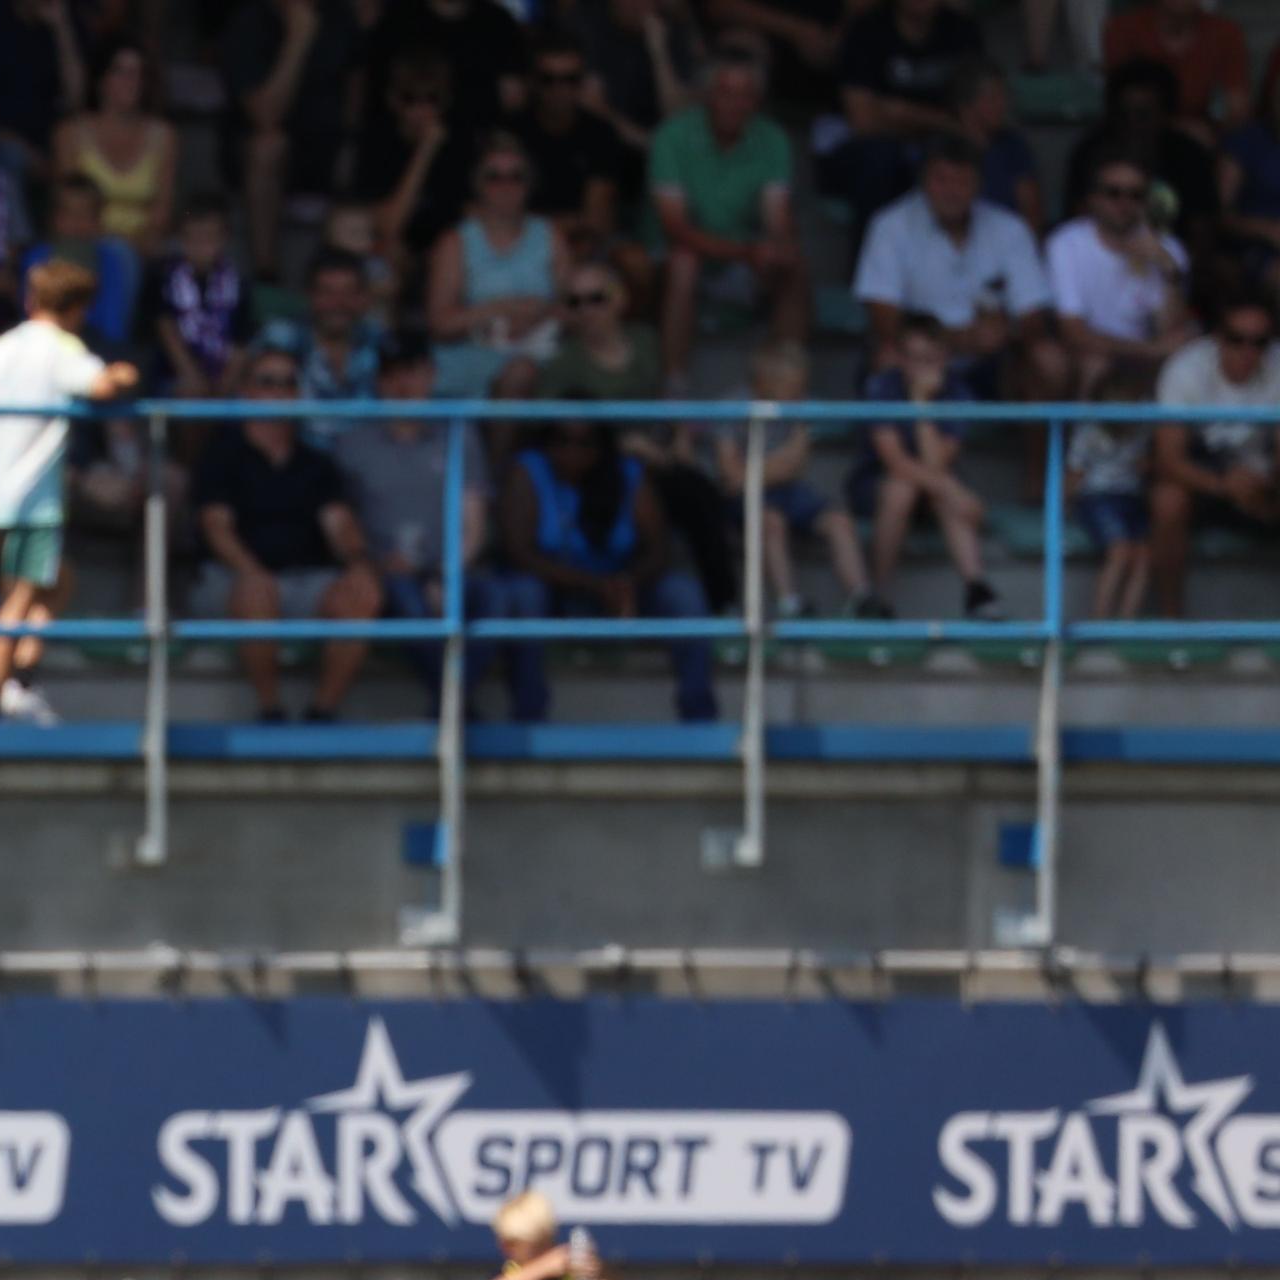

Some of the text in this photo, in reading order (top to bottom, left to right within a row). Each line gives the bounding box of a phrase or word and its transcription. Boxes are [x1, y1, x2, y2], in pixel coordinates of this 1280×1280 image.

[152, 1105, 826, 1228] STAR SPORT TV
[931, 1106, 1198, 1229] STAR
